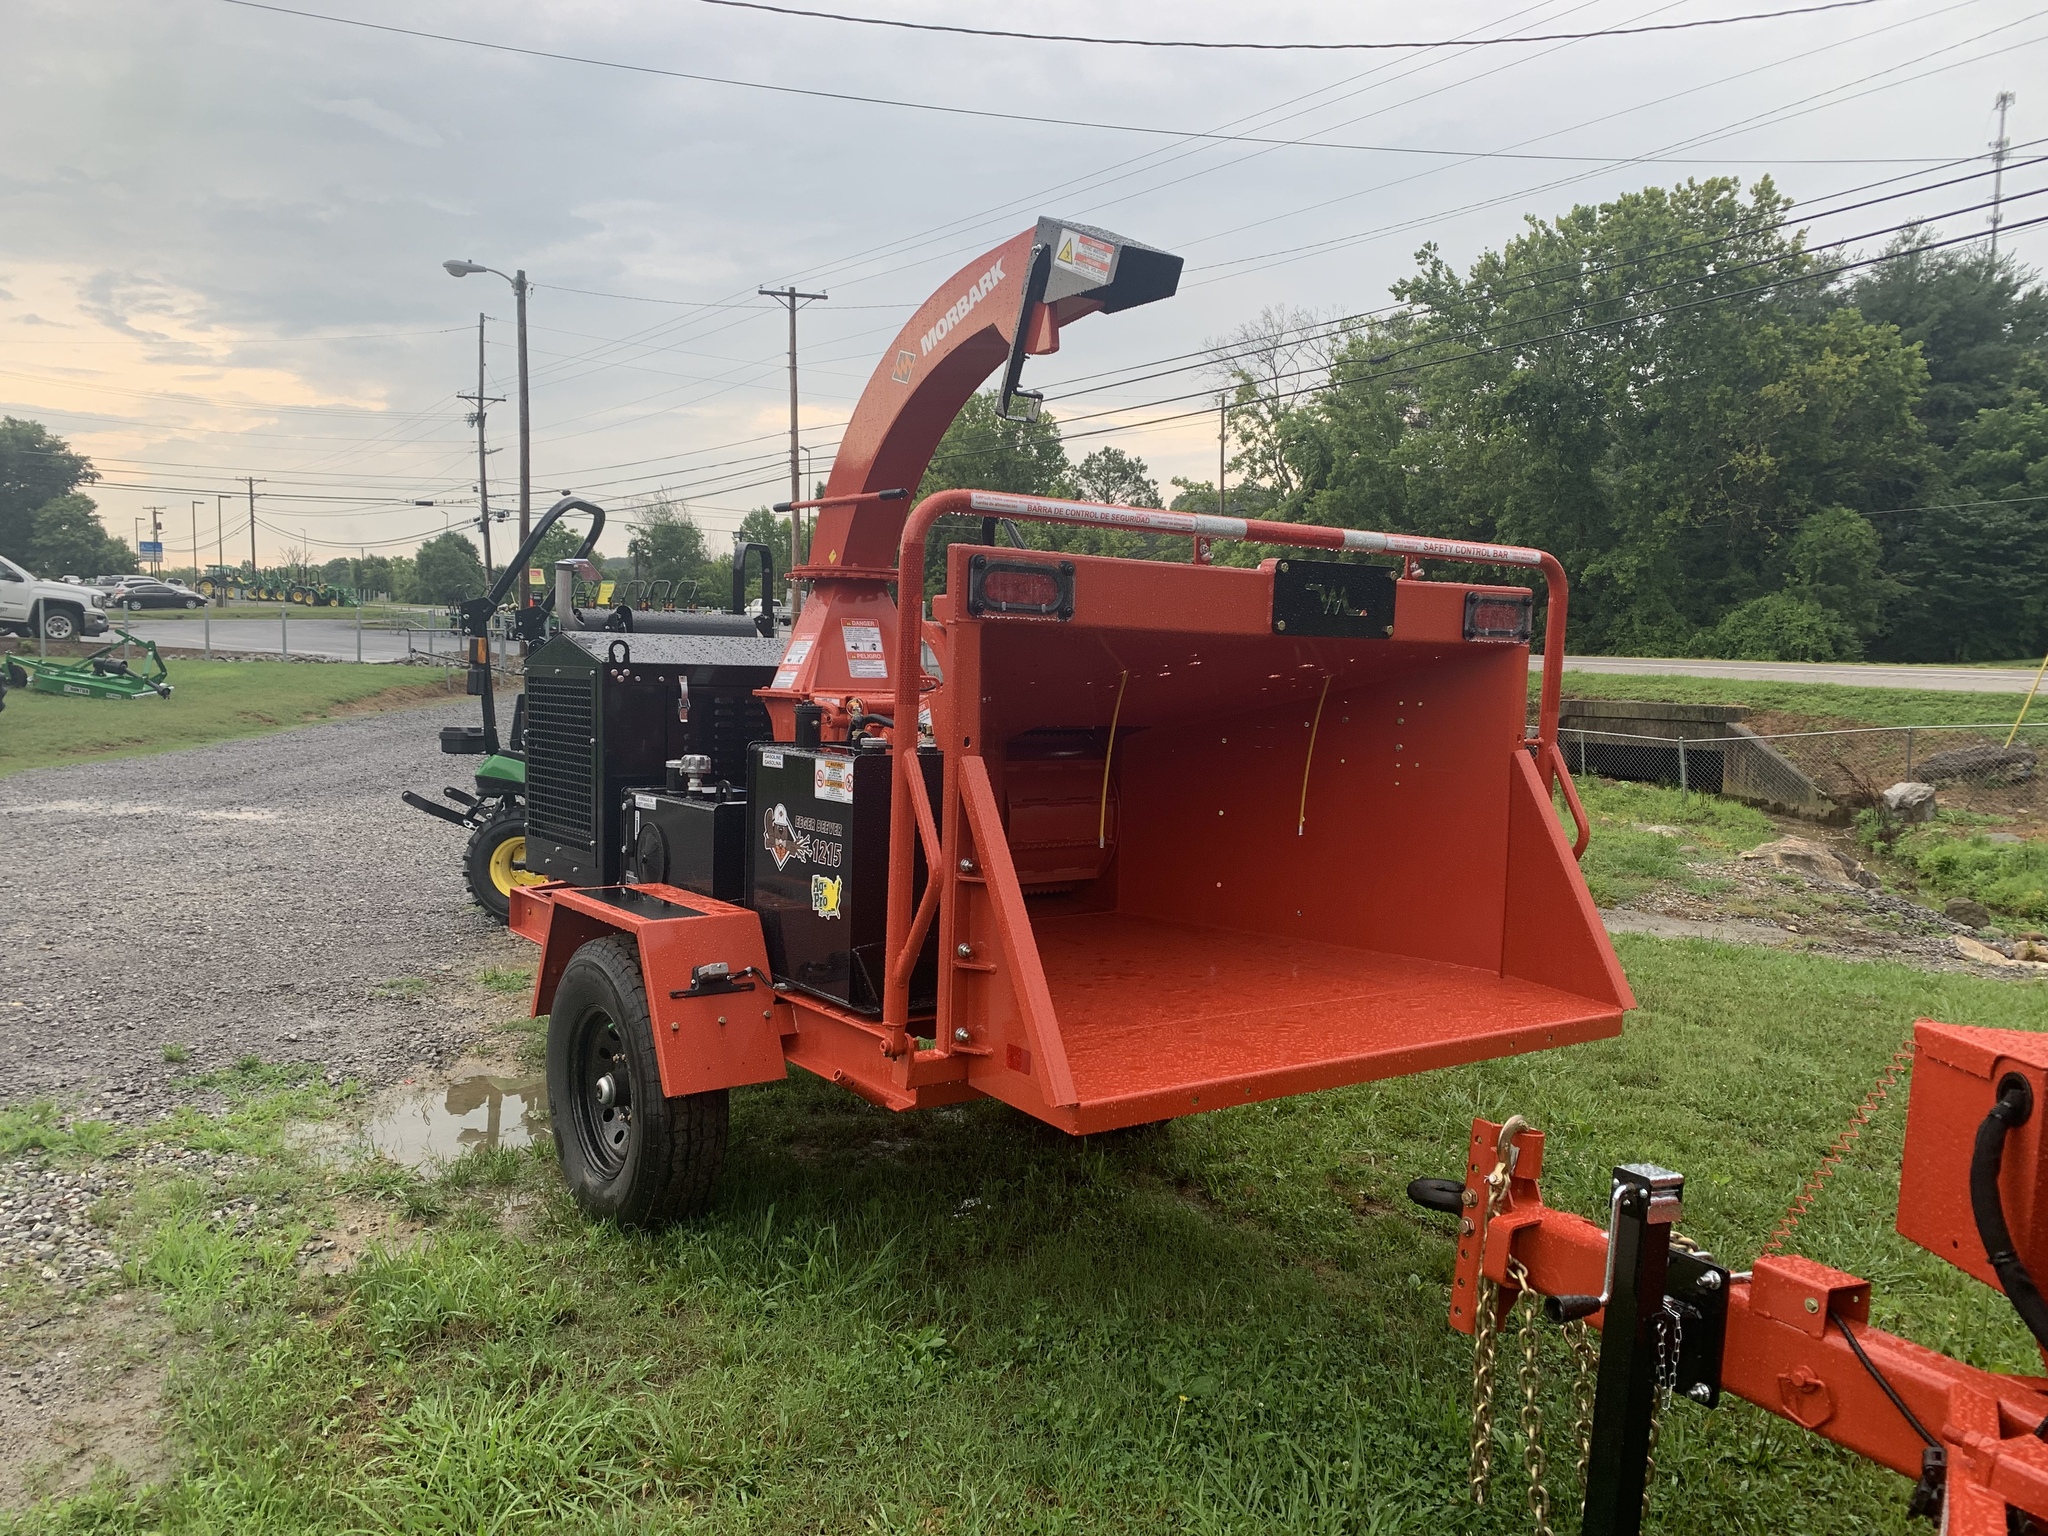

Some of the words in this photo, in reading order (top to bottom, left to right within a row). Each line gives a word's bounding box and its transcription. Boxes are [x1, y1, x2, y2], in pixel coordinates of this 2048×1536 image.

[920, 256, 1006, 356] MORBARK
[1027, 504, 1052, 514] BARRA
[1054, 507, 1063, 515] DE
[1065, 509, 1098, 519] CONTROL
[1111, 513, 1150, 524] SEGURIDAD
[1423, 542, 1454, 552] SAFETY
[1455, 545, 1491, 557] CONTROL
[1492, 549, 1509, 559] BAR
[816, 819, 842, 837] BEEVER
[812, 838, 842, 868] 1215
[813, 893, 828, 908] Pro
